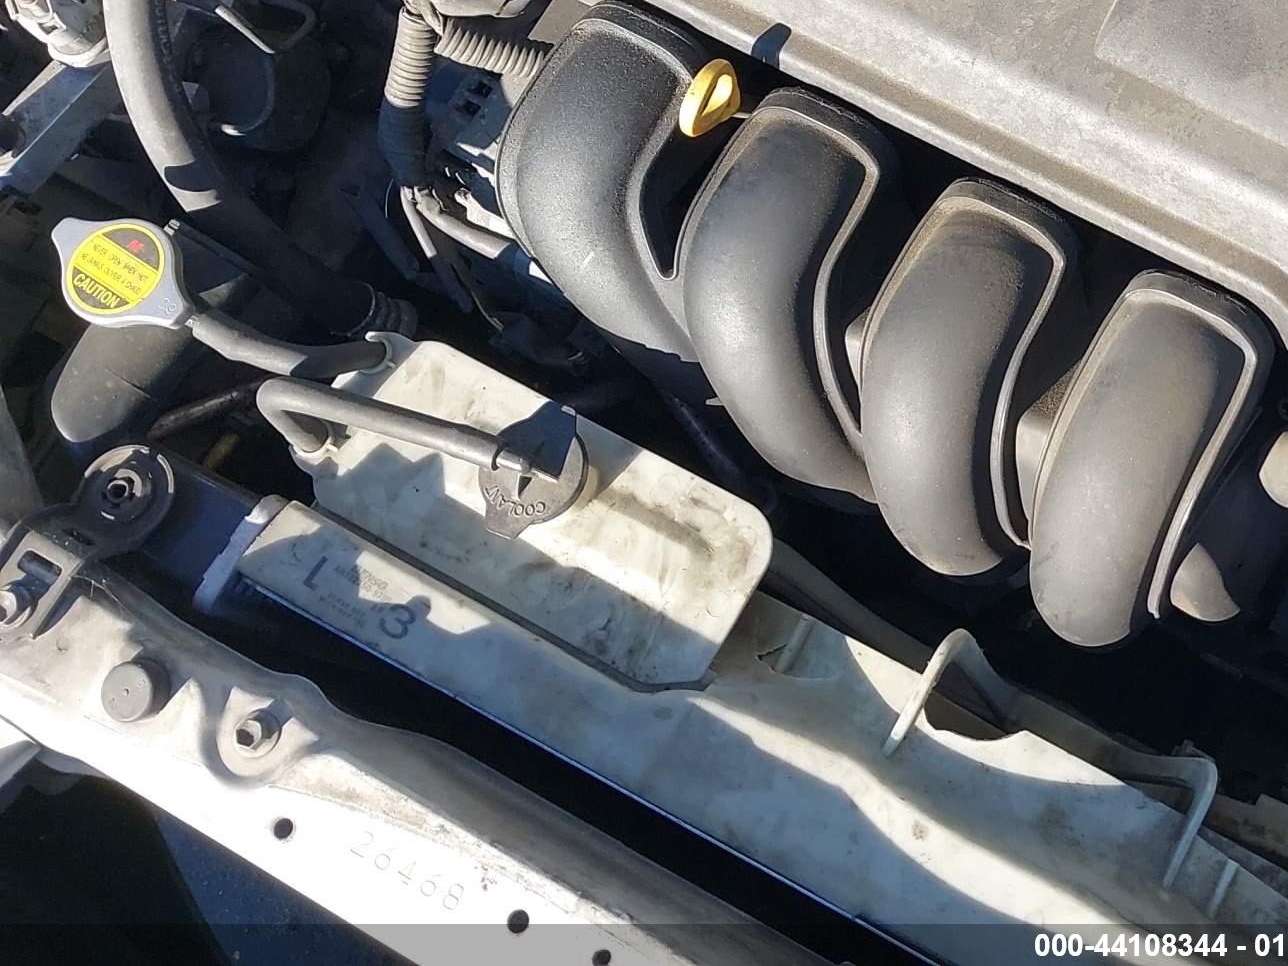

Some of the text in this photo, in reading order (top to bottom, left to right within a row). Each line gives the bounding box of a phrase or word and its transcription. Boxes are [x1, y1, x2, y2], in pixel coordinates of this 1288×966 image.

[73, 273, 121, 309] CAUTION
[303, 555, 328, 591] L
[379, 603, 416, 639] 3
[349, 830, 465, 911] 26468
